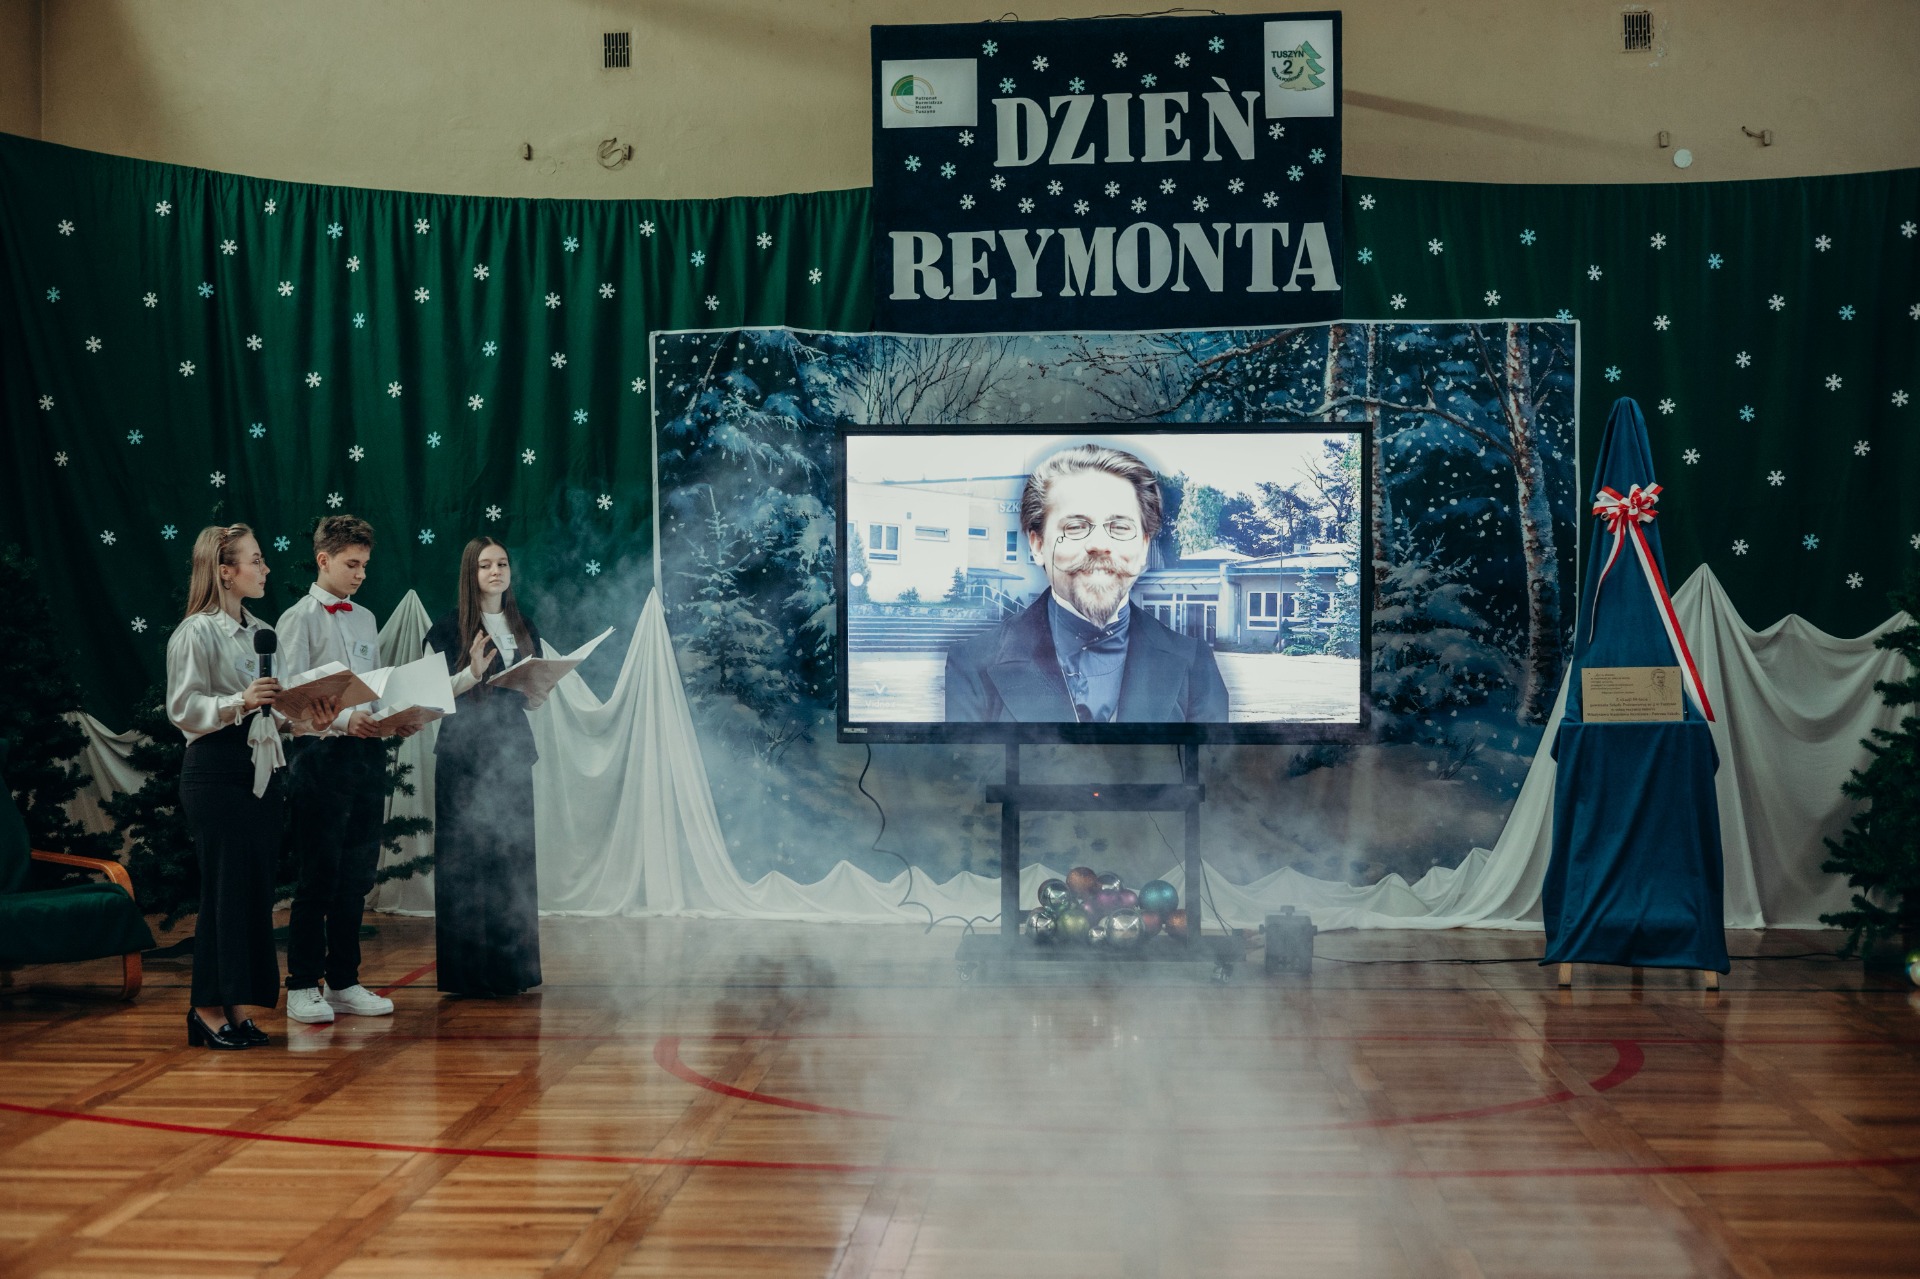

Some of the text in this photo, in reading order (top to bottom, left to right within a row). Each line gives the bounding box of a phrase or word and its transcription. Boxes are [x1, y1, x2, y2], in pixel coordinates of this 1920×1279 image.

[1271, 50, 1304, 58] TUSZYN
[1283, 60, 1293, 74] 2
[888, 221, 1341, 301] REYMONTA
